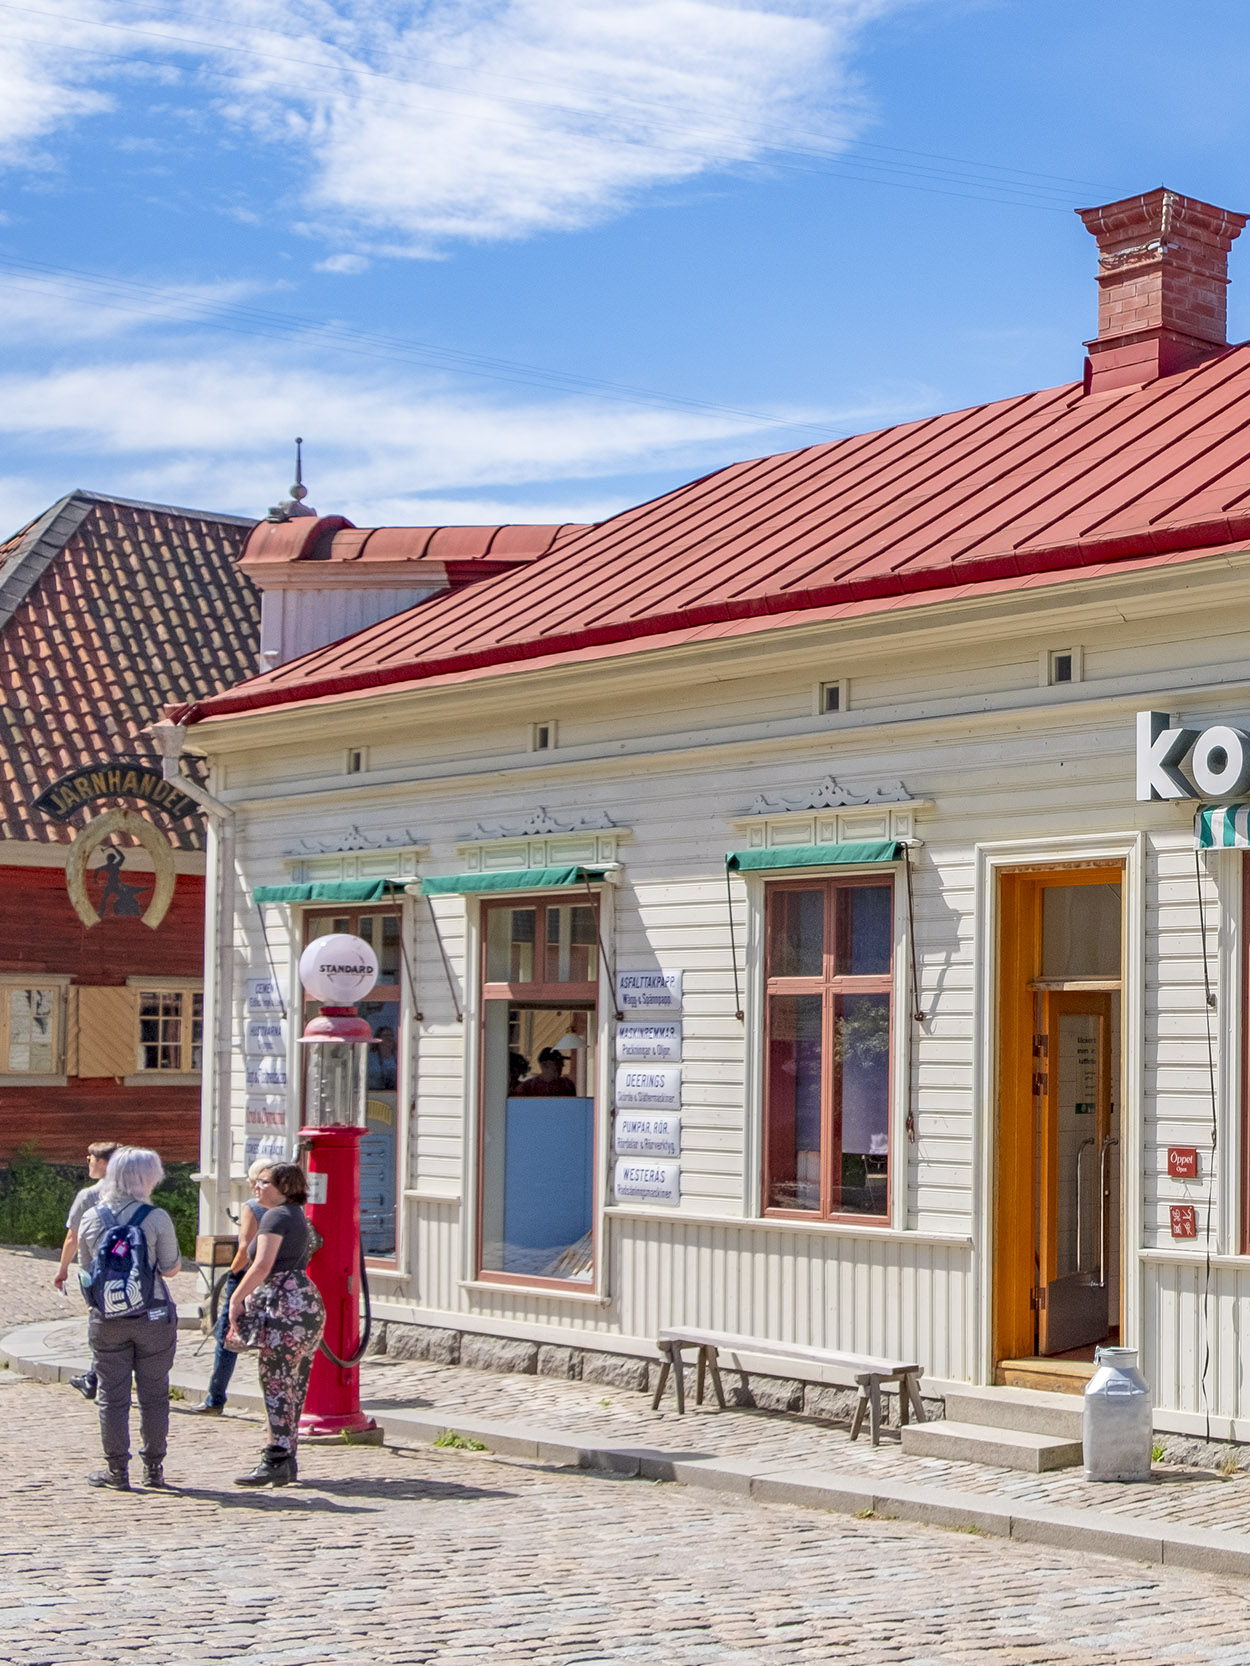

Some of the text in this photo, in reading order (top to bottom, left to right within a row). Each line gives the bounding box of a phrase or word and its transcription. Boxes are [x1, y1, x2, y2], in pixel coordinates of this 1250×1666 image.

[50, 769, 190, 816] JÄRNHANDEL
[319, 964, 374, 974] STANDARD
[625, 1073, 666, 1088] DEERINGS
[1170, 1151, 1194, 1167] Öppet
[623, 1166, 666, 1184] WESTERÅS
[1175, 1166, 1188, 1174] Open
